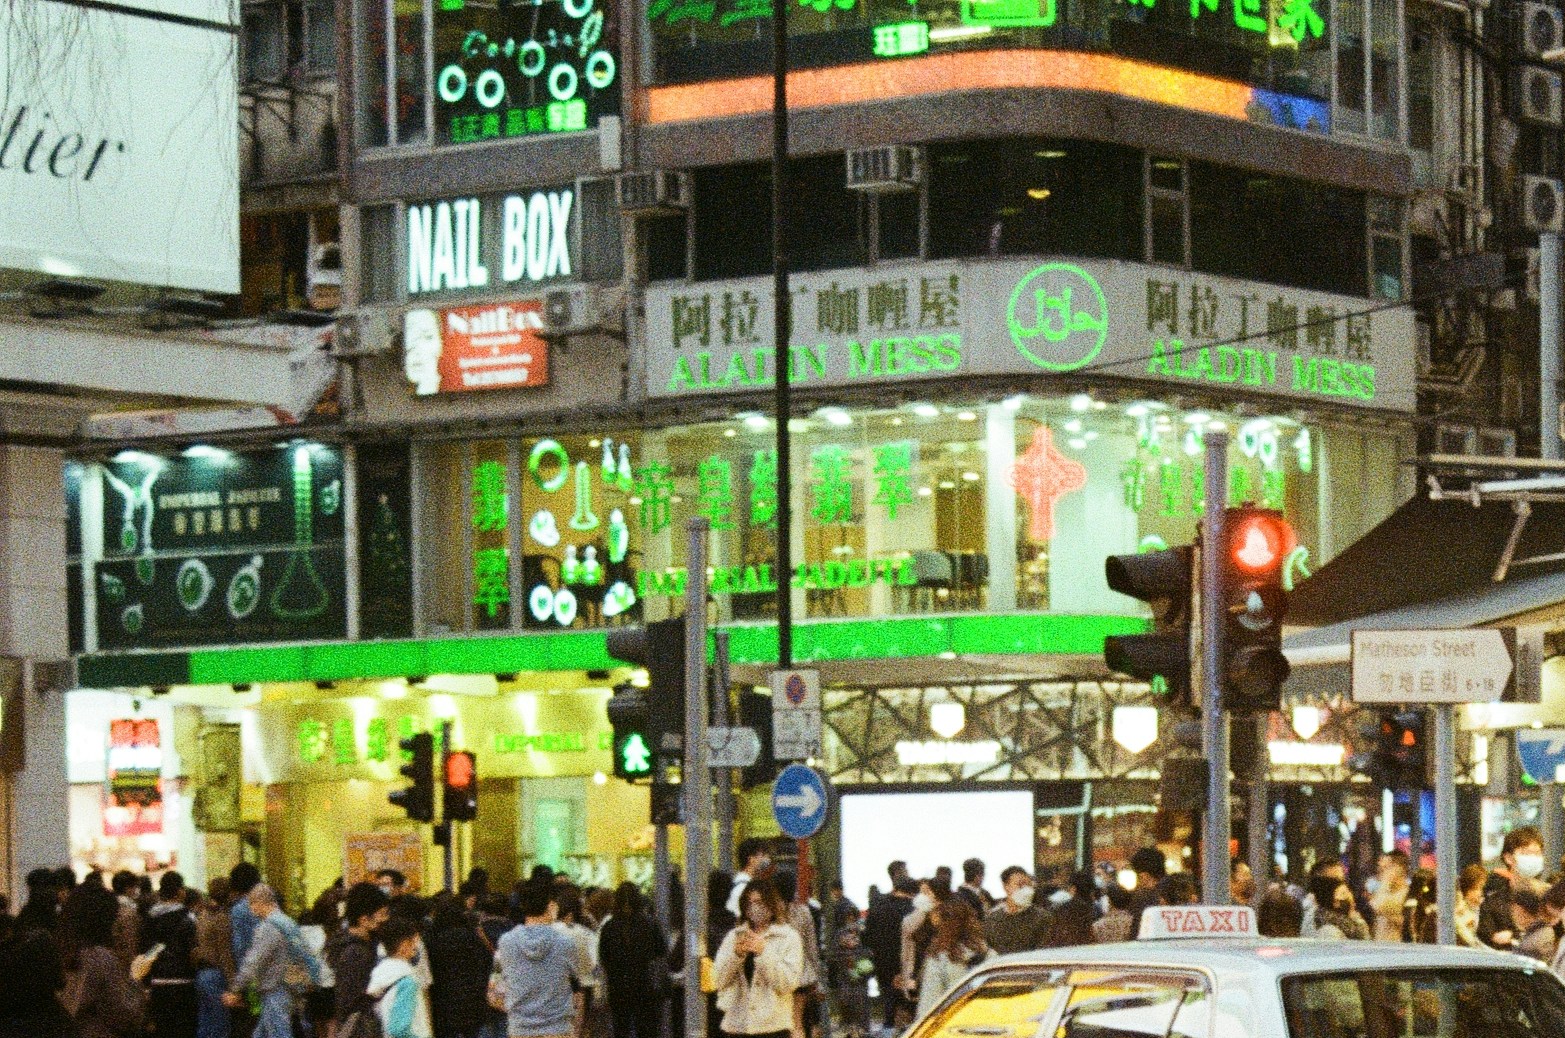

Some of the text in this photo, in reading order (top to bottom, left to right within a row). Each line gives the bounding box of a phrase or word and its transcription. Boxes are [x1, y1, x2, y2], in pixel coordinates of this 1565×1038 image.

[408, 189, 573, 294] NAIL BOX
[665, 333, 962, 392] ALADIN MESS
[1146, 337, 1377, 400] ALADIN MESS
[636, 563, 778, 598] IMPRIAL
[1360, 638, 1477, 658] Matheson Street
[1160, 909, 1250, 934] TAXI
